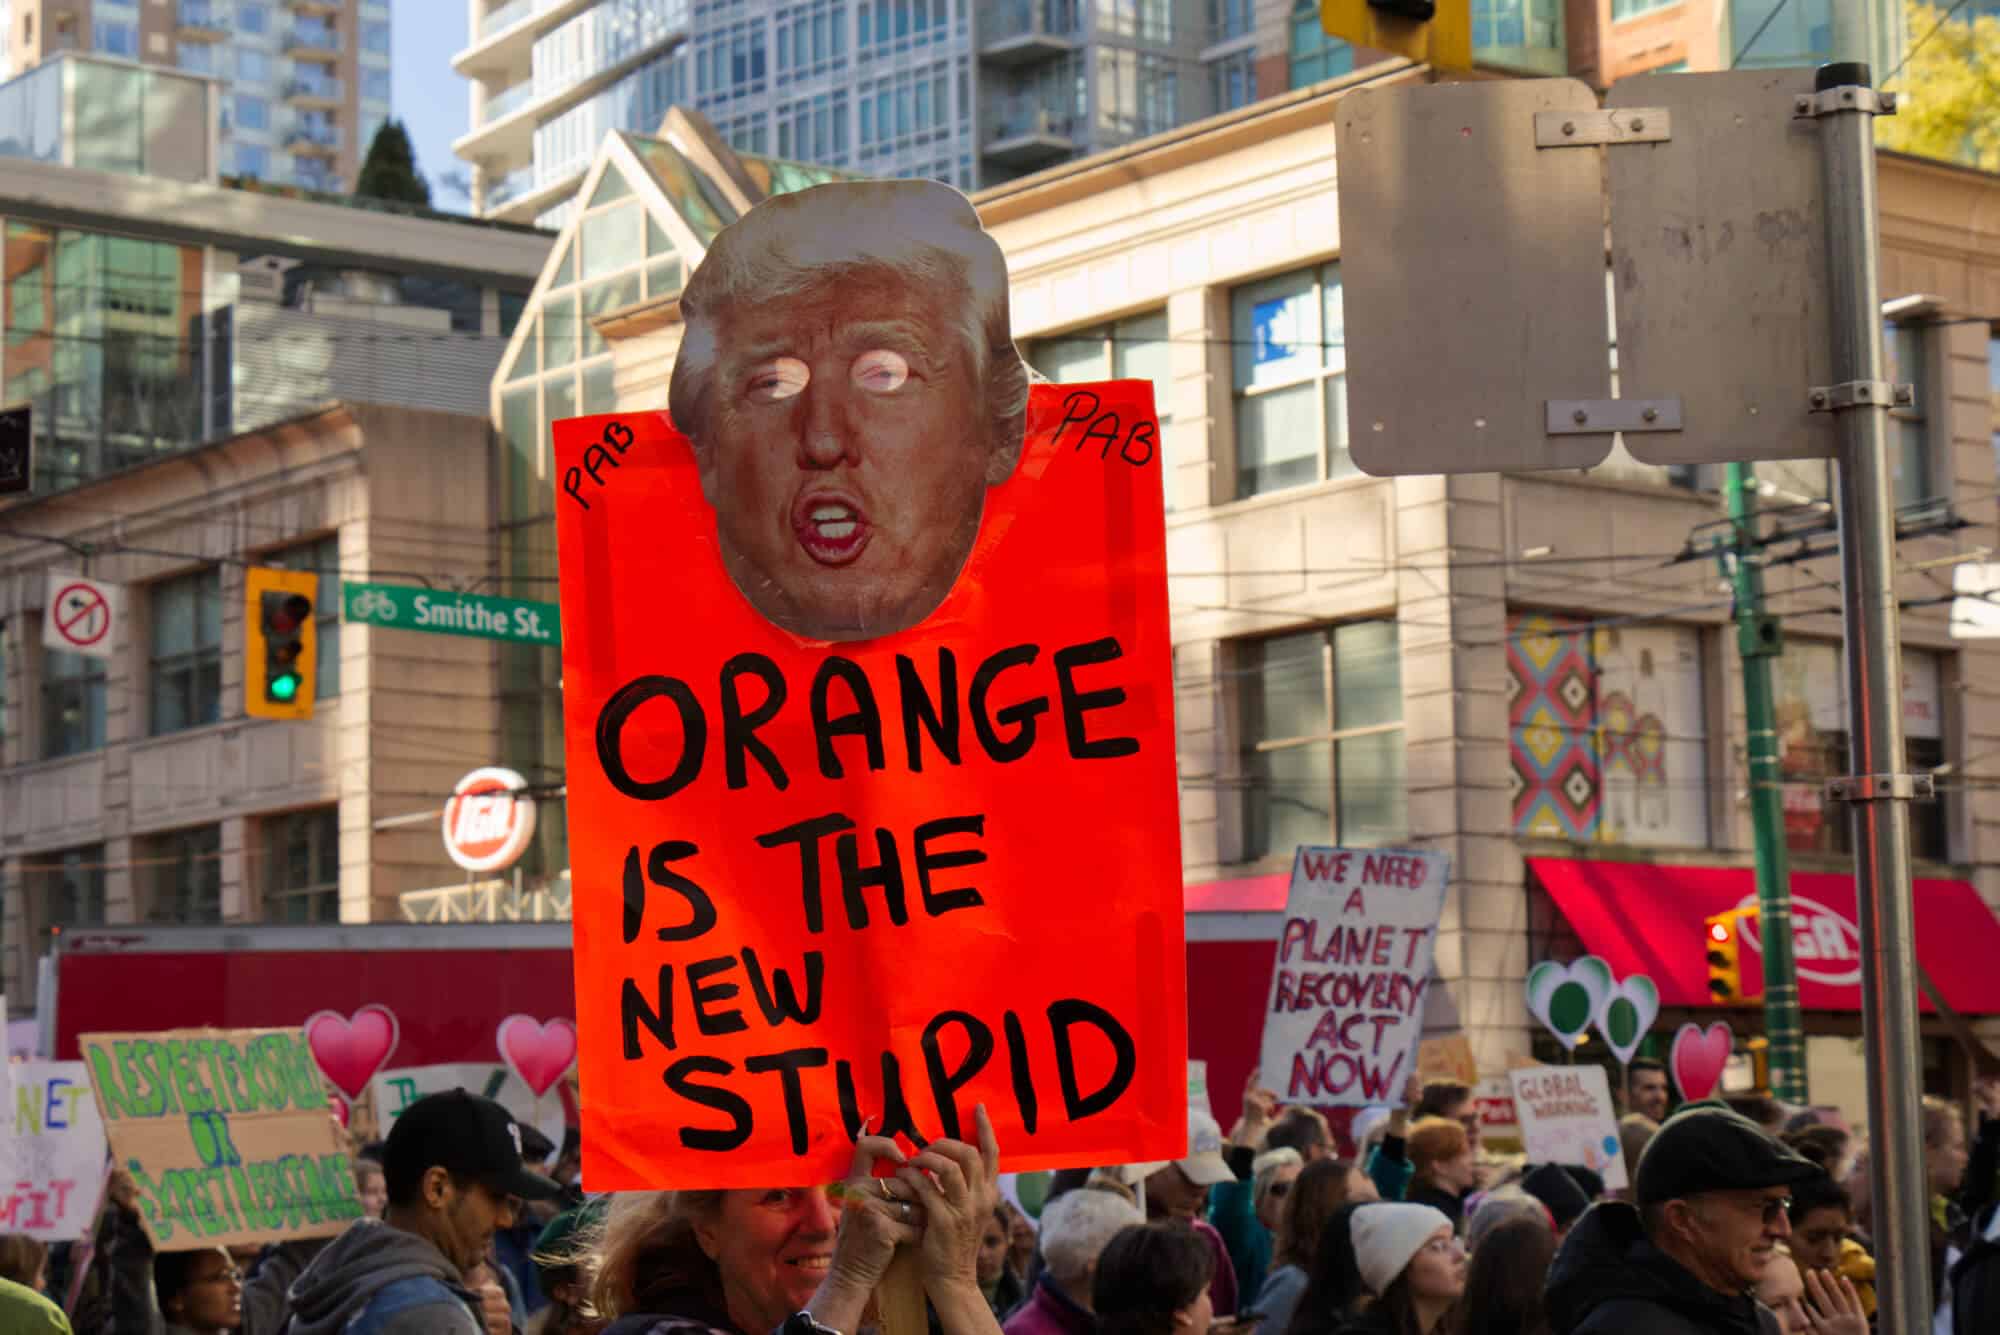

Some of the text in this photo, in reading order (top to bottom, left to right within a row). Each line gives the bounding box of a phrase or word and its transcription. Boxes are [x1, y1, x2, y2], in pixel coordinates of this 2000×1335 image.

[1051, 391, 1154, 466] PAB
[564, 422, 633, 510] PAB
[413, 595, 550, 638] Smithe St.
[596, 637, 1139, 800] ORANGE
[623, 813, 987, 943] IS THE
[1303, 852, 1427, 889] WE NEED
[1344, 887, 1366, 917] A
[1280, 917, 1429, 968] PLANET
[1789, 914, 1850, 960] GA
[622, 946, 825, 1060] NEW
[1274, 970, 1427, 1016] RECOVERY
[1306, 1009, 1401, 1057] ACT
[663, 998, 1136, 1156] STUPID
[1288, 1050, 1404, 1101] NOW
[1518, 1073, 1592, 1100] GLOBAL
[188, 1110, 241, 1168] OR
